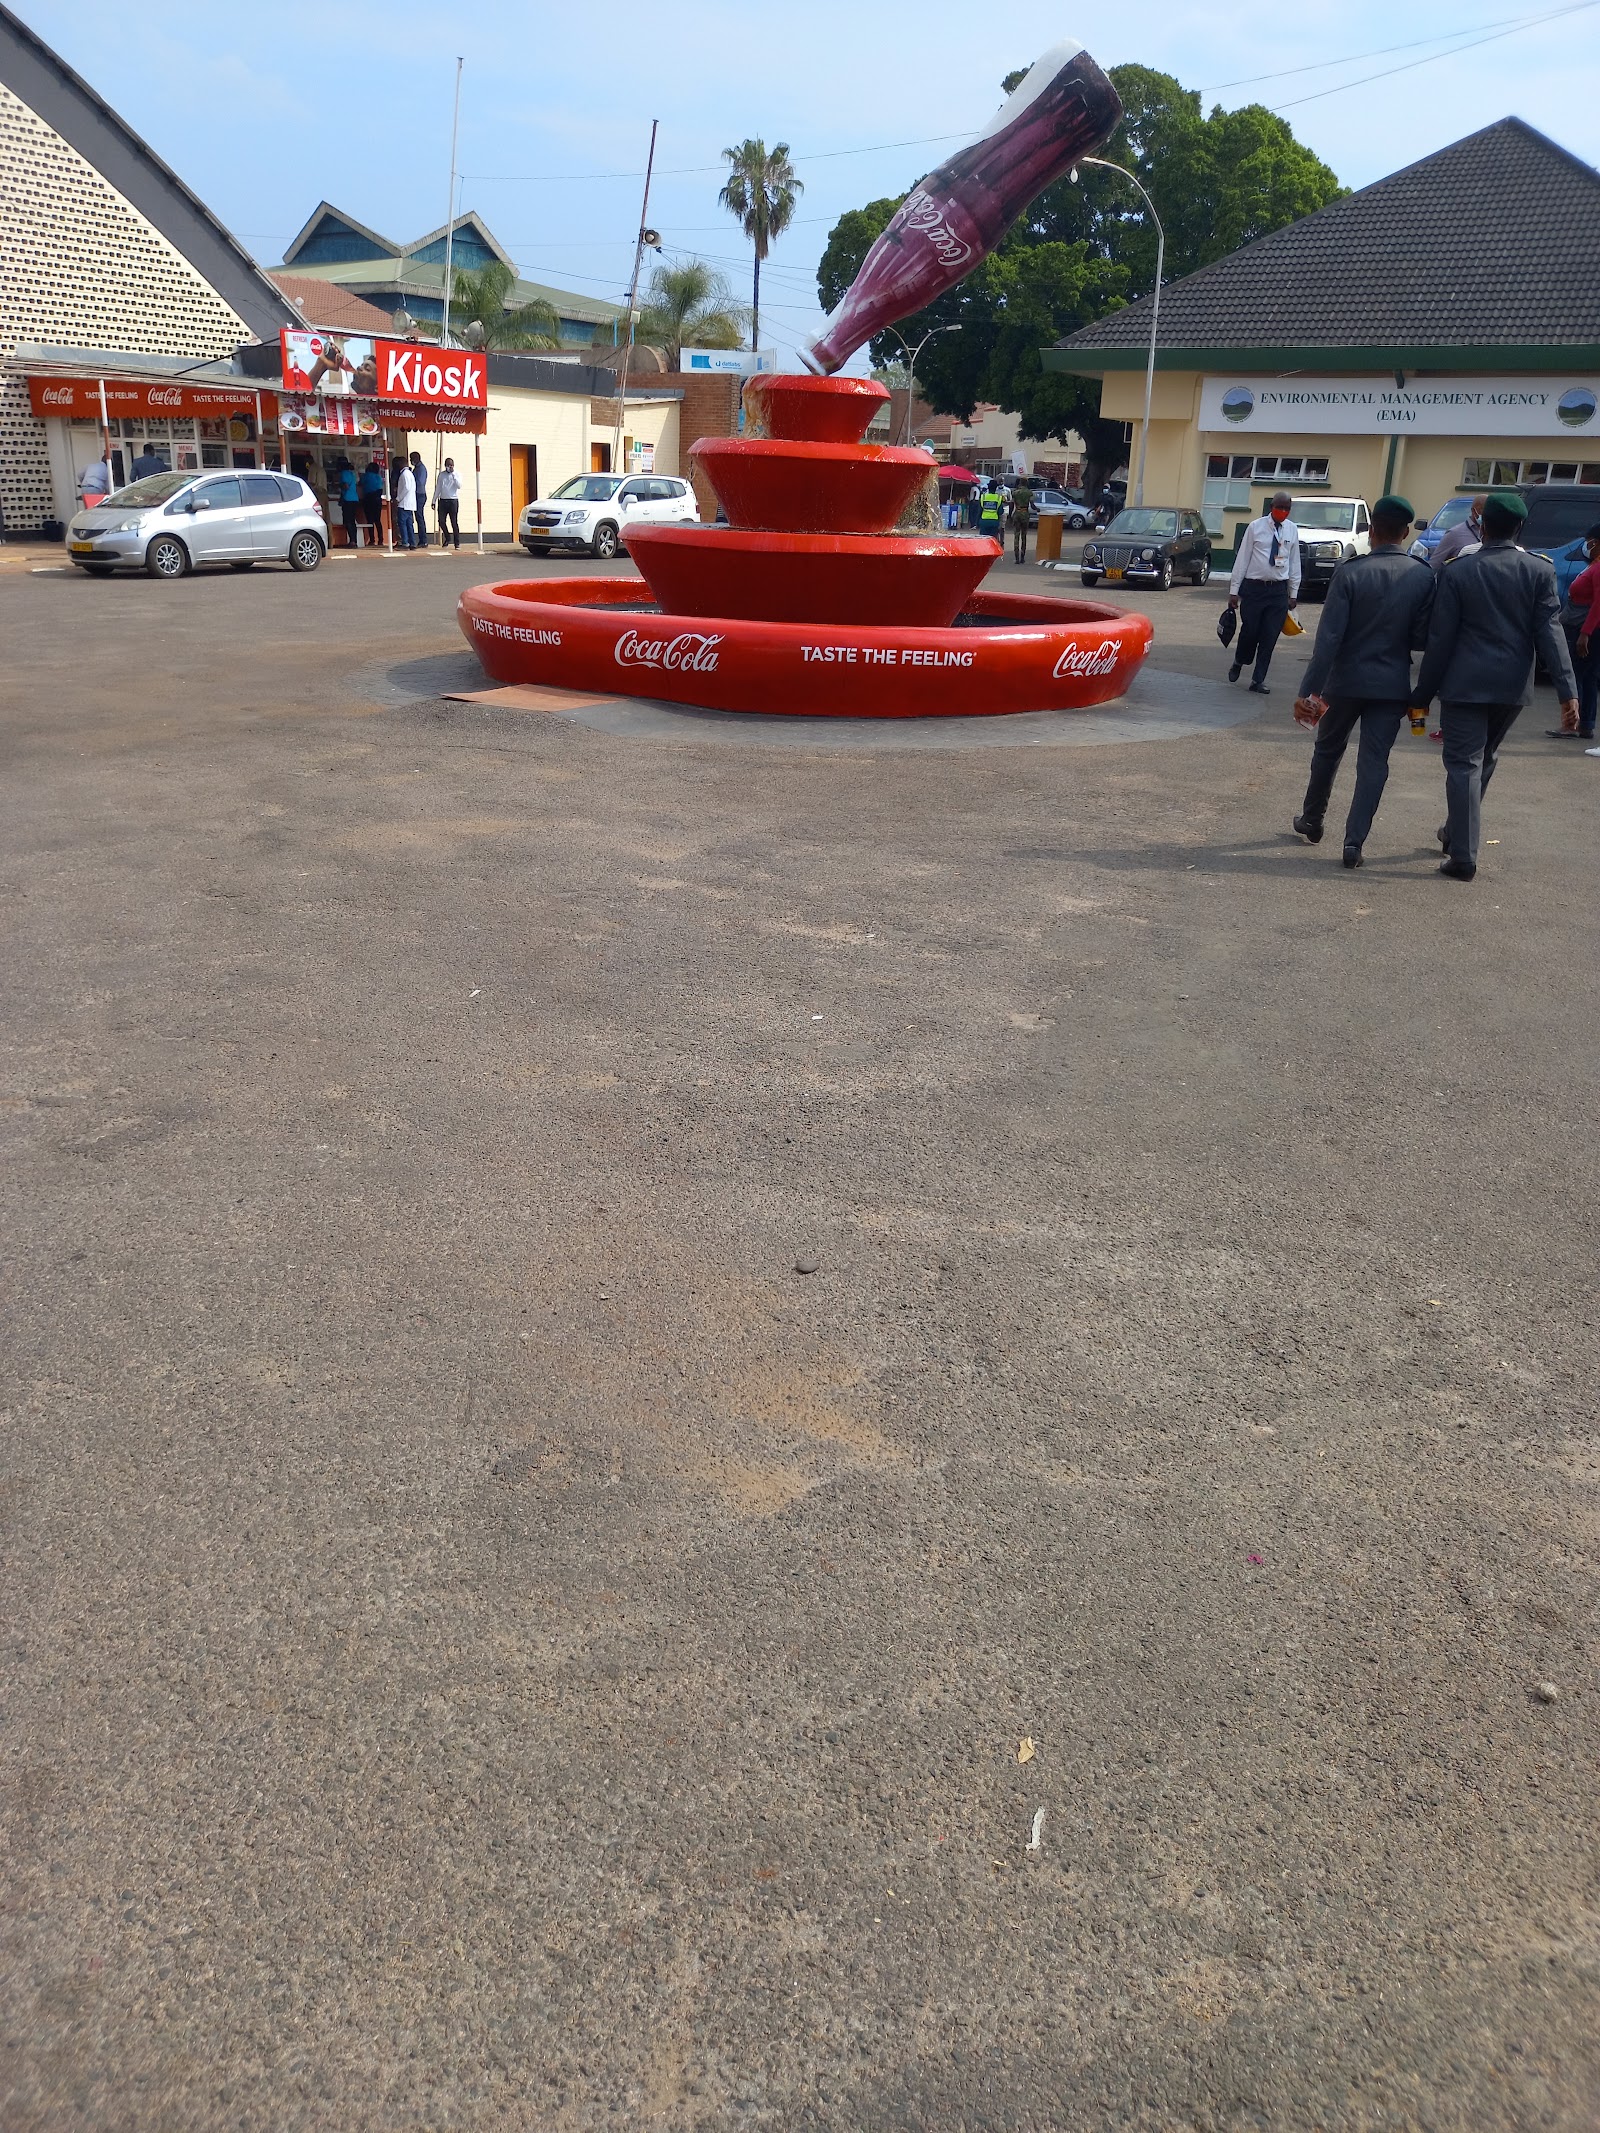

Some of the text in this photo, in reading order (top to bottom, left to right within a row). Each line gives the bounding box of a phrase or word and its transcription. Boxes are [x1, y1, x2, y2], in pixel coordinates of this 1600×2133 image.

[898, 190, 972, 267] Coca-Cola
[386, 349, 481, 400] Kiosk
[42, 387, 74, 405] Coca-Cola
[104, 391, 114, 400] HE
[114, 391, 139, 400] FEELING
[147, 387, 182, 406] Coca-Cola
[192, 394, 252, 404] TASTE THE FEELING
[1260, 392, 1549, 405] ENVIRONMENTAL MANAGEMENT AGENCY
[378, 408, 416, 418] THE FEELING
[435, 408, 468, 426] Coca-Cola
[1376, 409, 1416, 423] (EMA)
[472, 617, 562, 646] TASTE THE FEELING
[614, 629, 726, 672] Coca-Cola
[800, 646, 973, 667] TASTE THE FEELING
[1053, 640, 1122, 679] Coca-Cola
